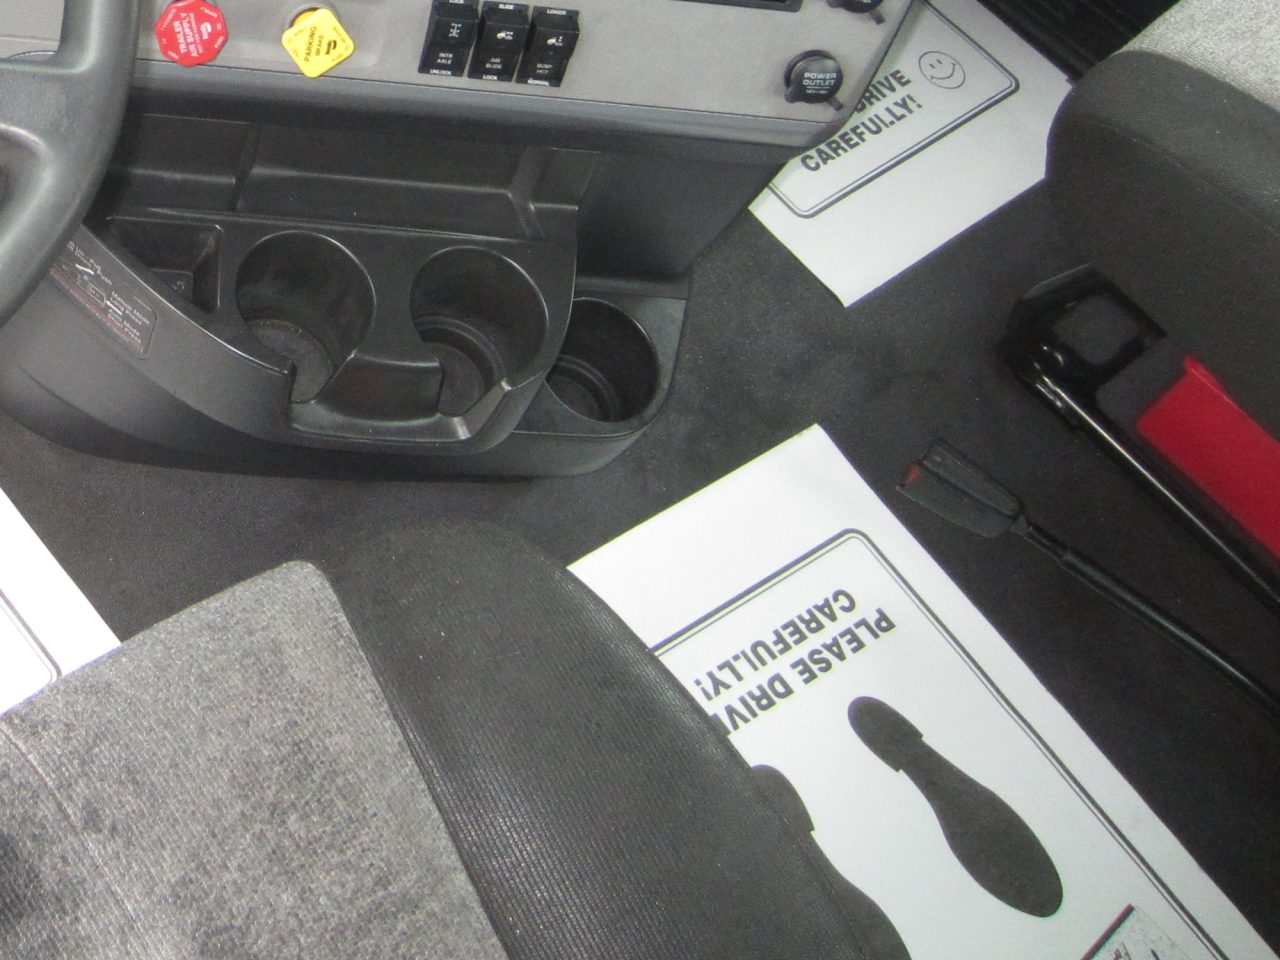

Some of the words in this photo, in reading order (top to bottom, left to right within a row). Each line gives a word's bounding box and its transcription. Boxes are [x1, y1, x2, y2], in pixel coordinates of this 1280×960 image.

[173, 20, 189, 54] TRAILER
[180, 12, 195, 43] SUPPLY
[303, 26, 317, 62] PARKING
[188, 43, 200, 57] AIR
[528, 78, 550, 87] NORMAL
[800, 93, 923, 172] CAREFULLY!
[693, 589, 856, 701] CAREFULLY!
[789, 607, 896, 685] PLEASE
